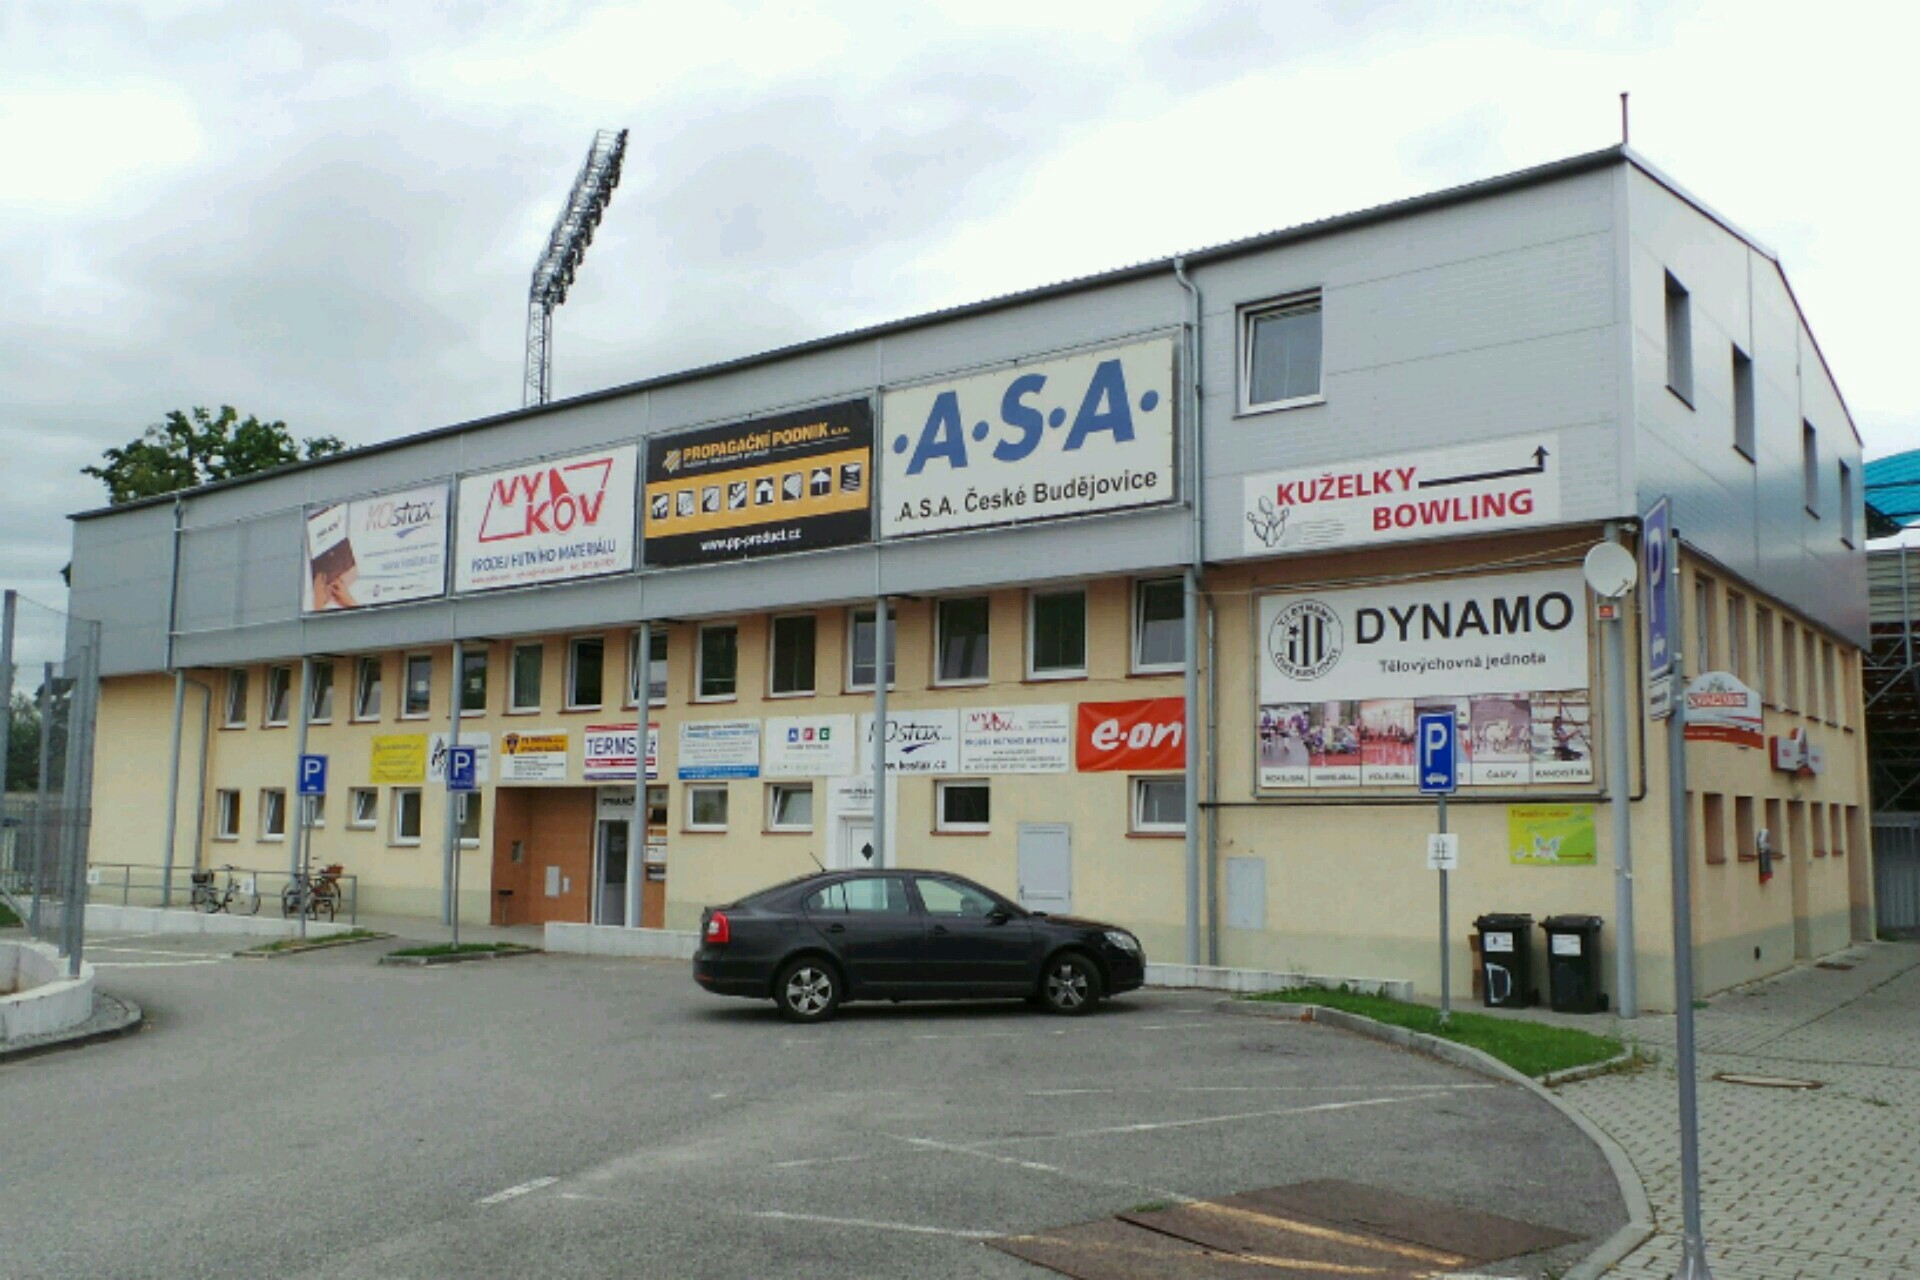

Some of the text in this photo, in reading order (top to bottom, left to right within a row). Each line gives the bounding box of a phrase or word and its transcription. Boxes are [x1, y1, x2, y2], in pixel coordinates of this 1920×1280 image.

[683, 430, 771, 462] PROPAGAČNÍ
[772, 422, 828, 446] PODNIK
[965, 486, 1027, 513] České
[1033, 469, 1158, 504] Budějovice
[1276, 465, 1417, 507] KUŽELKY
[1373, 489, 1533, 531] BOWLING
[700, 528, 802, 551] www.pp-product.cz
[1649, 527, 1663, 623] P
[1356, 591, 1573, 644] DYNAMO
[1379, 653, 1547, 676] Tělovýchovná jednota
[454, 751, 471, 778] P
[587, 736, 637, 754] TERMS
[1425, 722, 1447, 768] P
[304, 758, 321, 782] P
